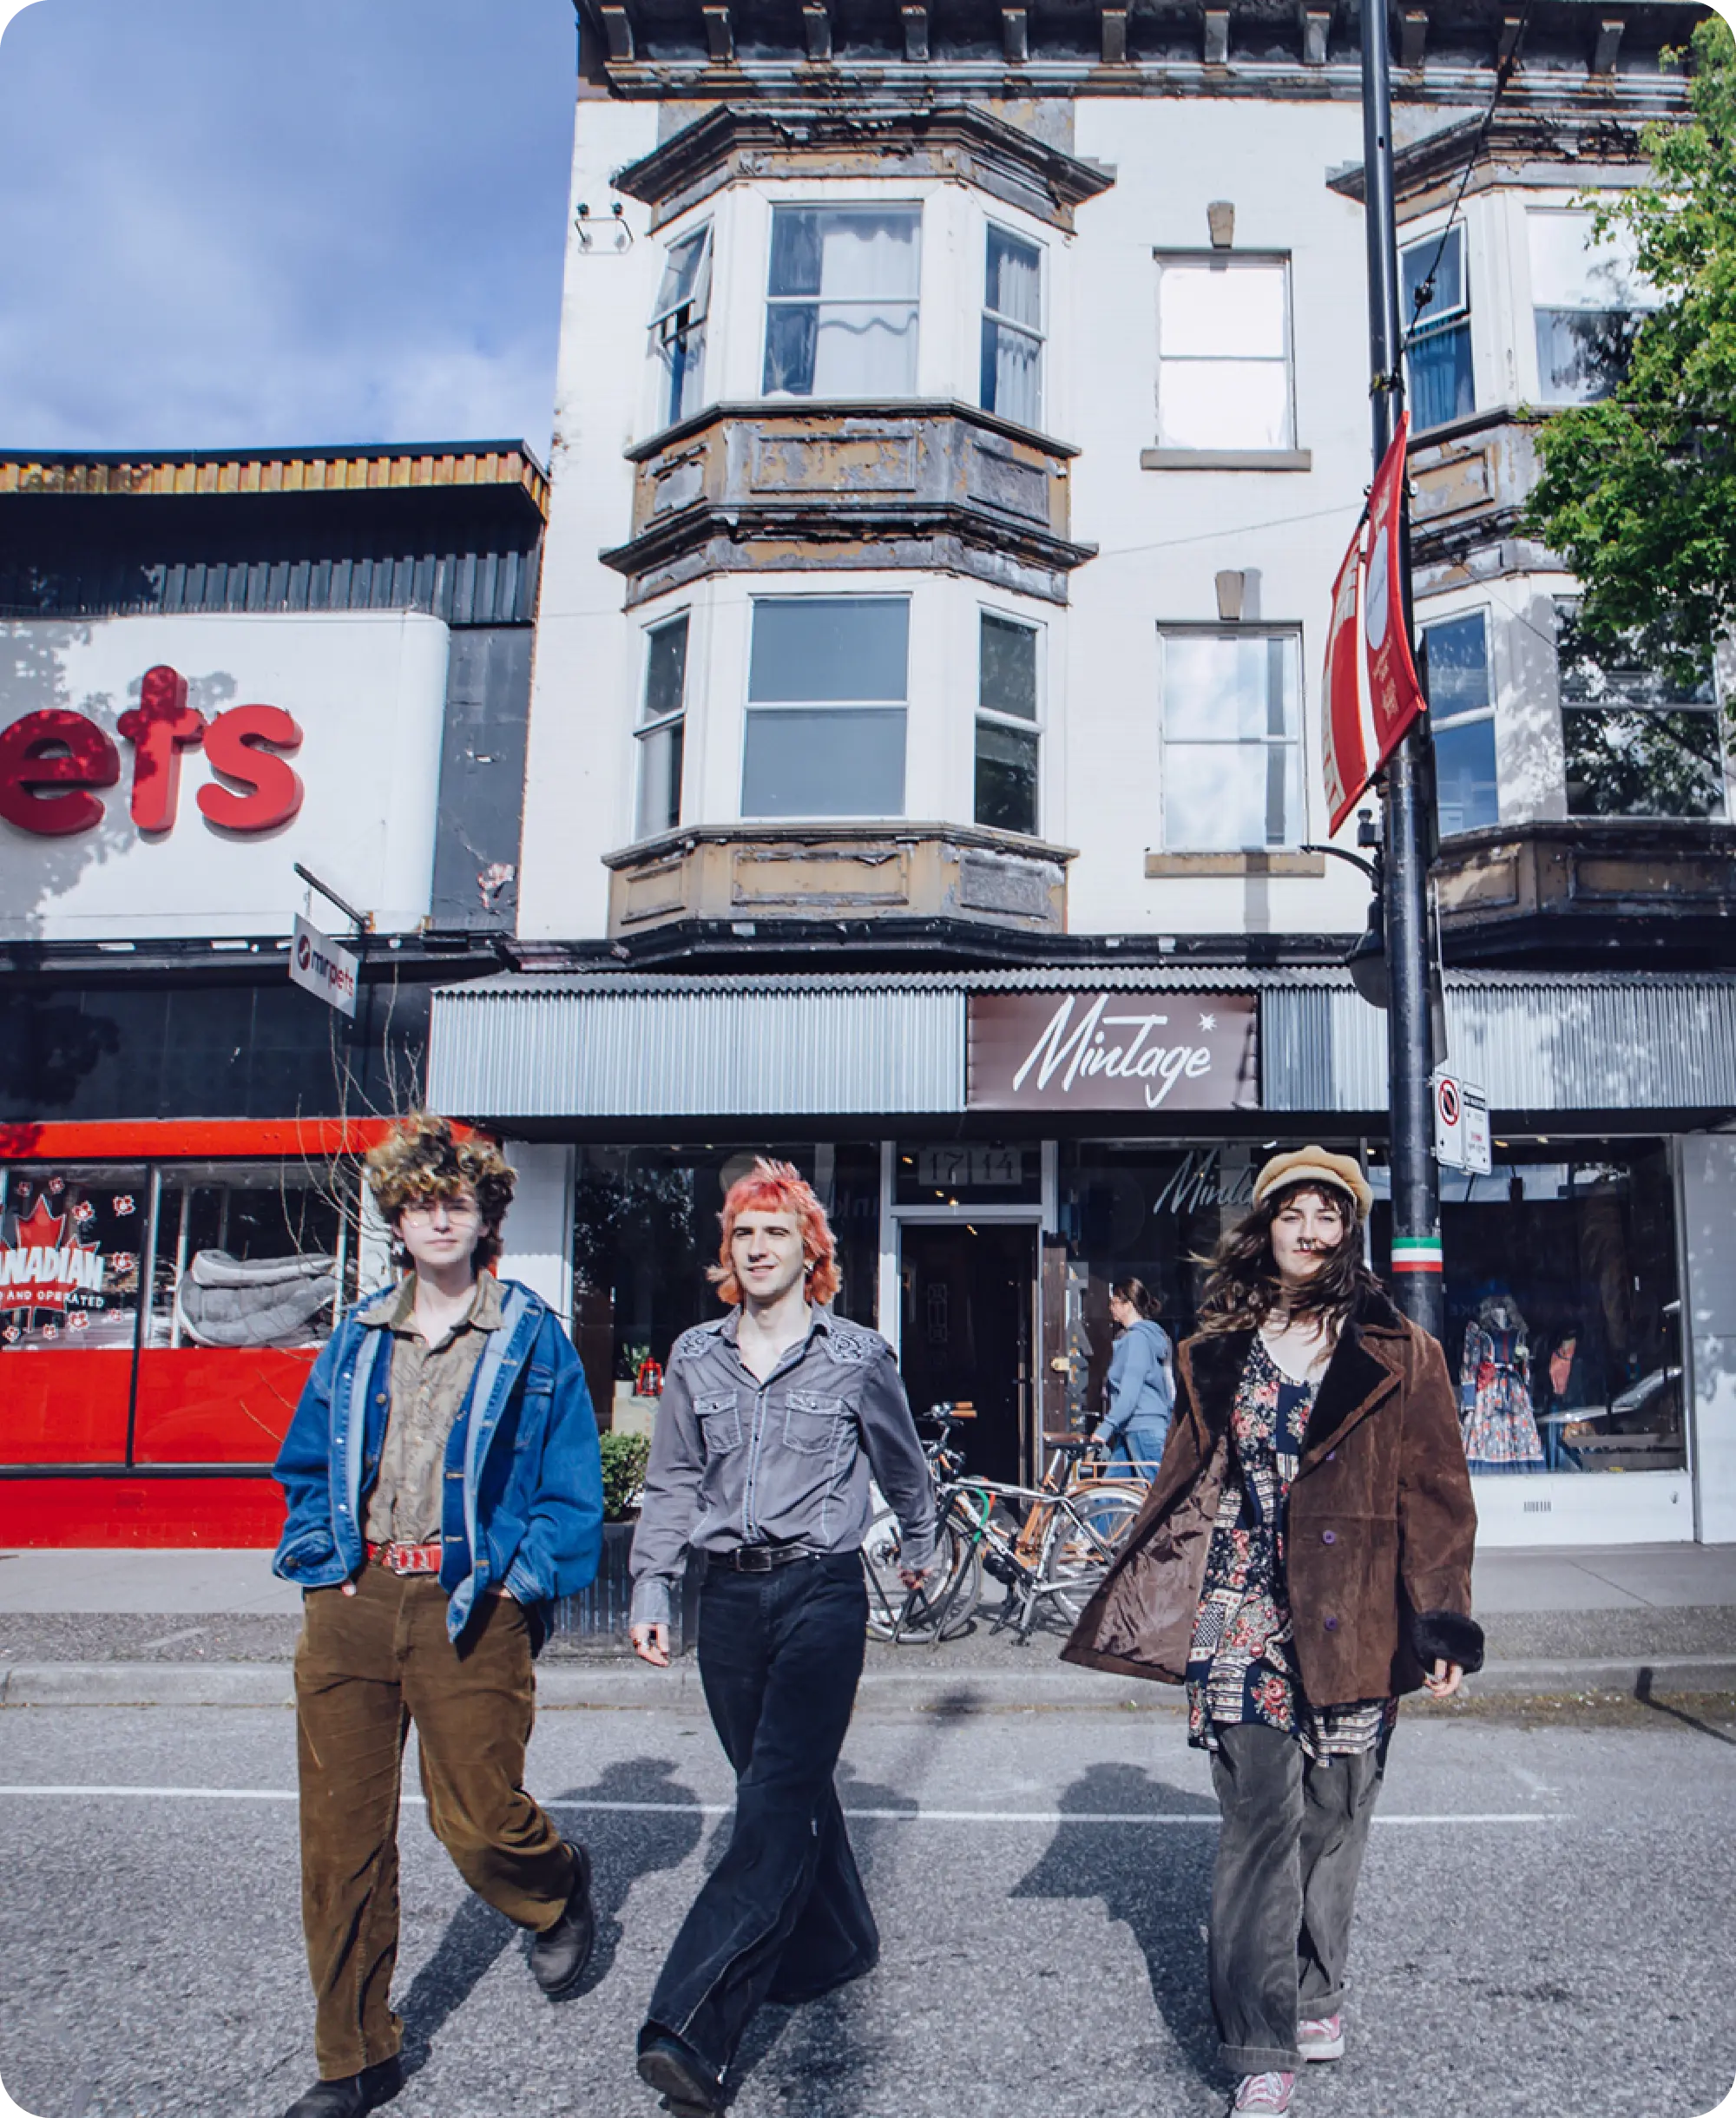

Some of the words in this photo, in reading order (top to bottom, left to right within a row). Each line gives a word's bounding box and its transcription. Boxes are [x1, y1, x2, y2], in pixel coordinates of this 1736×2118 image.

[0, 664, 305, 836] ets
[1153, 1148, 1255, 1214] Minta
[0, 1246, 104, 1292] NADIAN
[7, 1289, 32, 1300] AND
[37, 1290, 104, 1307] OPERATED
